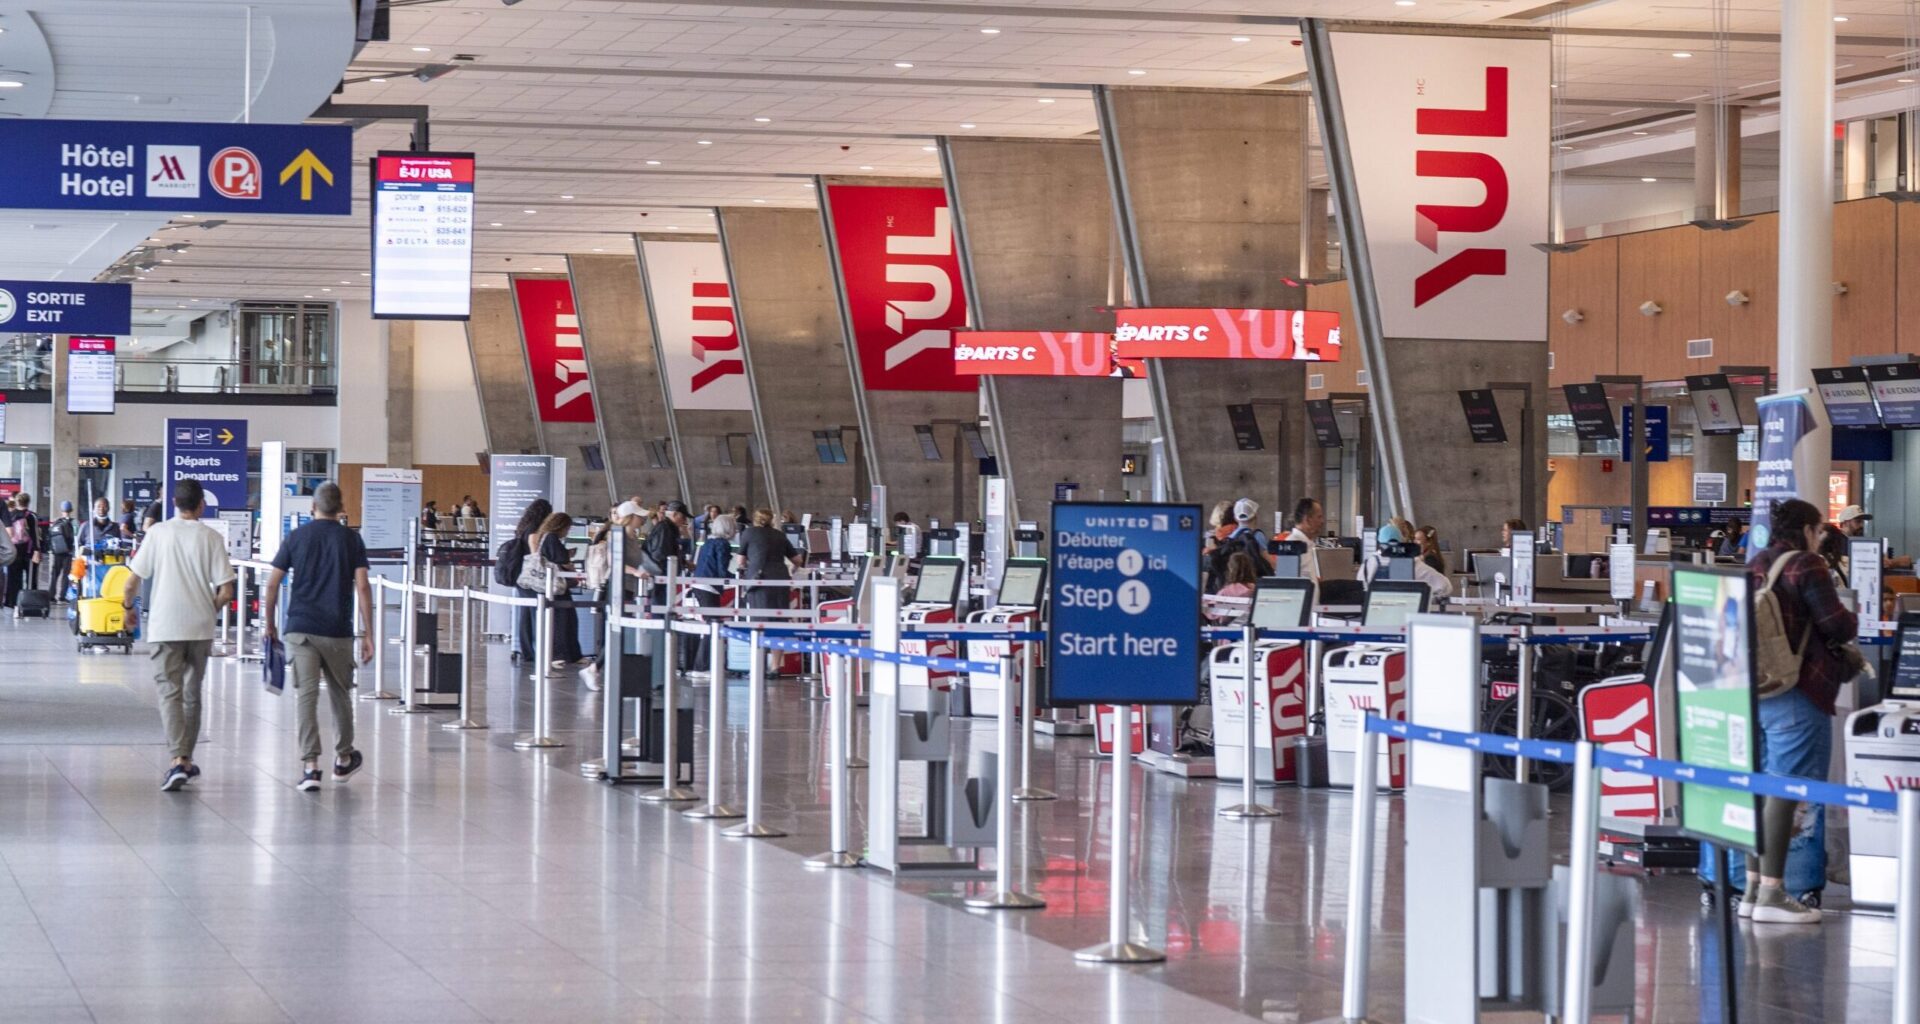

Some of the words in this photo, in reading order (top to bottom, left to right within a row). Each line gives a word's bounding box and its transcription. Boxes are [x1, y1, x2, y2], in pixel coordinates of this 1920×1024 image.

[61, 144, 134, 167] Hôtel
[428, 168, 453, 179] USA
[61, 173, 134, 196] Hotel
[1415, 67, 1508, 308] YUL
[885, 206, 952, 371] YUL
[27, 292, 86, 306] SORTIE
[27, 310, 64, 322] EXIT
[1192, 326, 1210, 342] C
[1021, 346, 1037, 361] C
[174, 455, 221, 469] Départs
[174, 470, 240, 482] Departures
[1085, 517, 1149, 528] UNITED
[1058, 531, 1126, 548] Débuter
[1058, 554, 1114, 573] l'étape
[1148, 555, 1167, 570] ici
[1060, 584, 1114, 611] Step
[1059, 632, 1118, 656] Start
[1124, 632, 1178, 656] here
[1271, 657, 1306, 770] YUL
